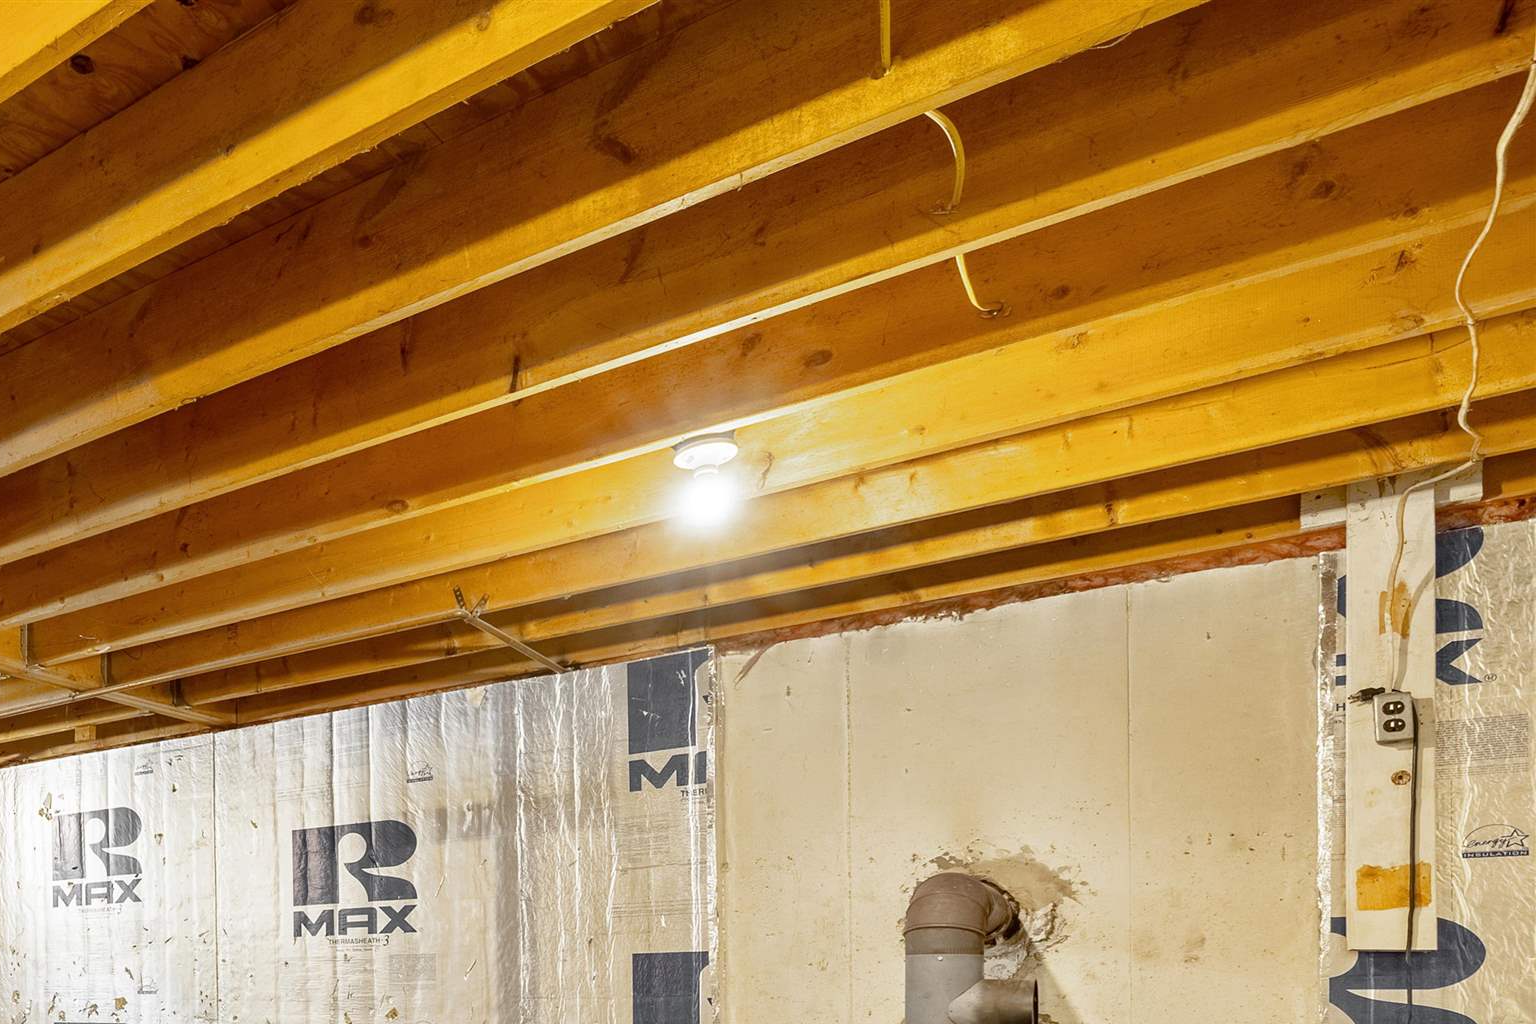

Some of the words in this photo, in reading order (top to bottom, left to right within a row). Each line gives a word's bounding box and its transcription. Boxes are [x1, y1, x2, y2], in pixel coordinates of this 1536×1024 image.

[52, 807, 143, 881] R
[1462, 850, 1529, 859] INSULATION
[292, 820, 417, 906] R
[52, 878, 143, 908] MAX
[293, 905, 418, 938] MAX
